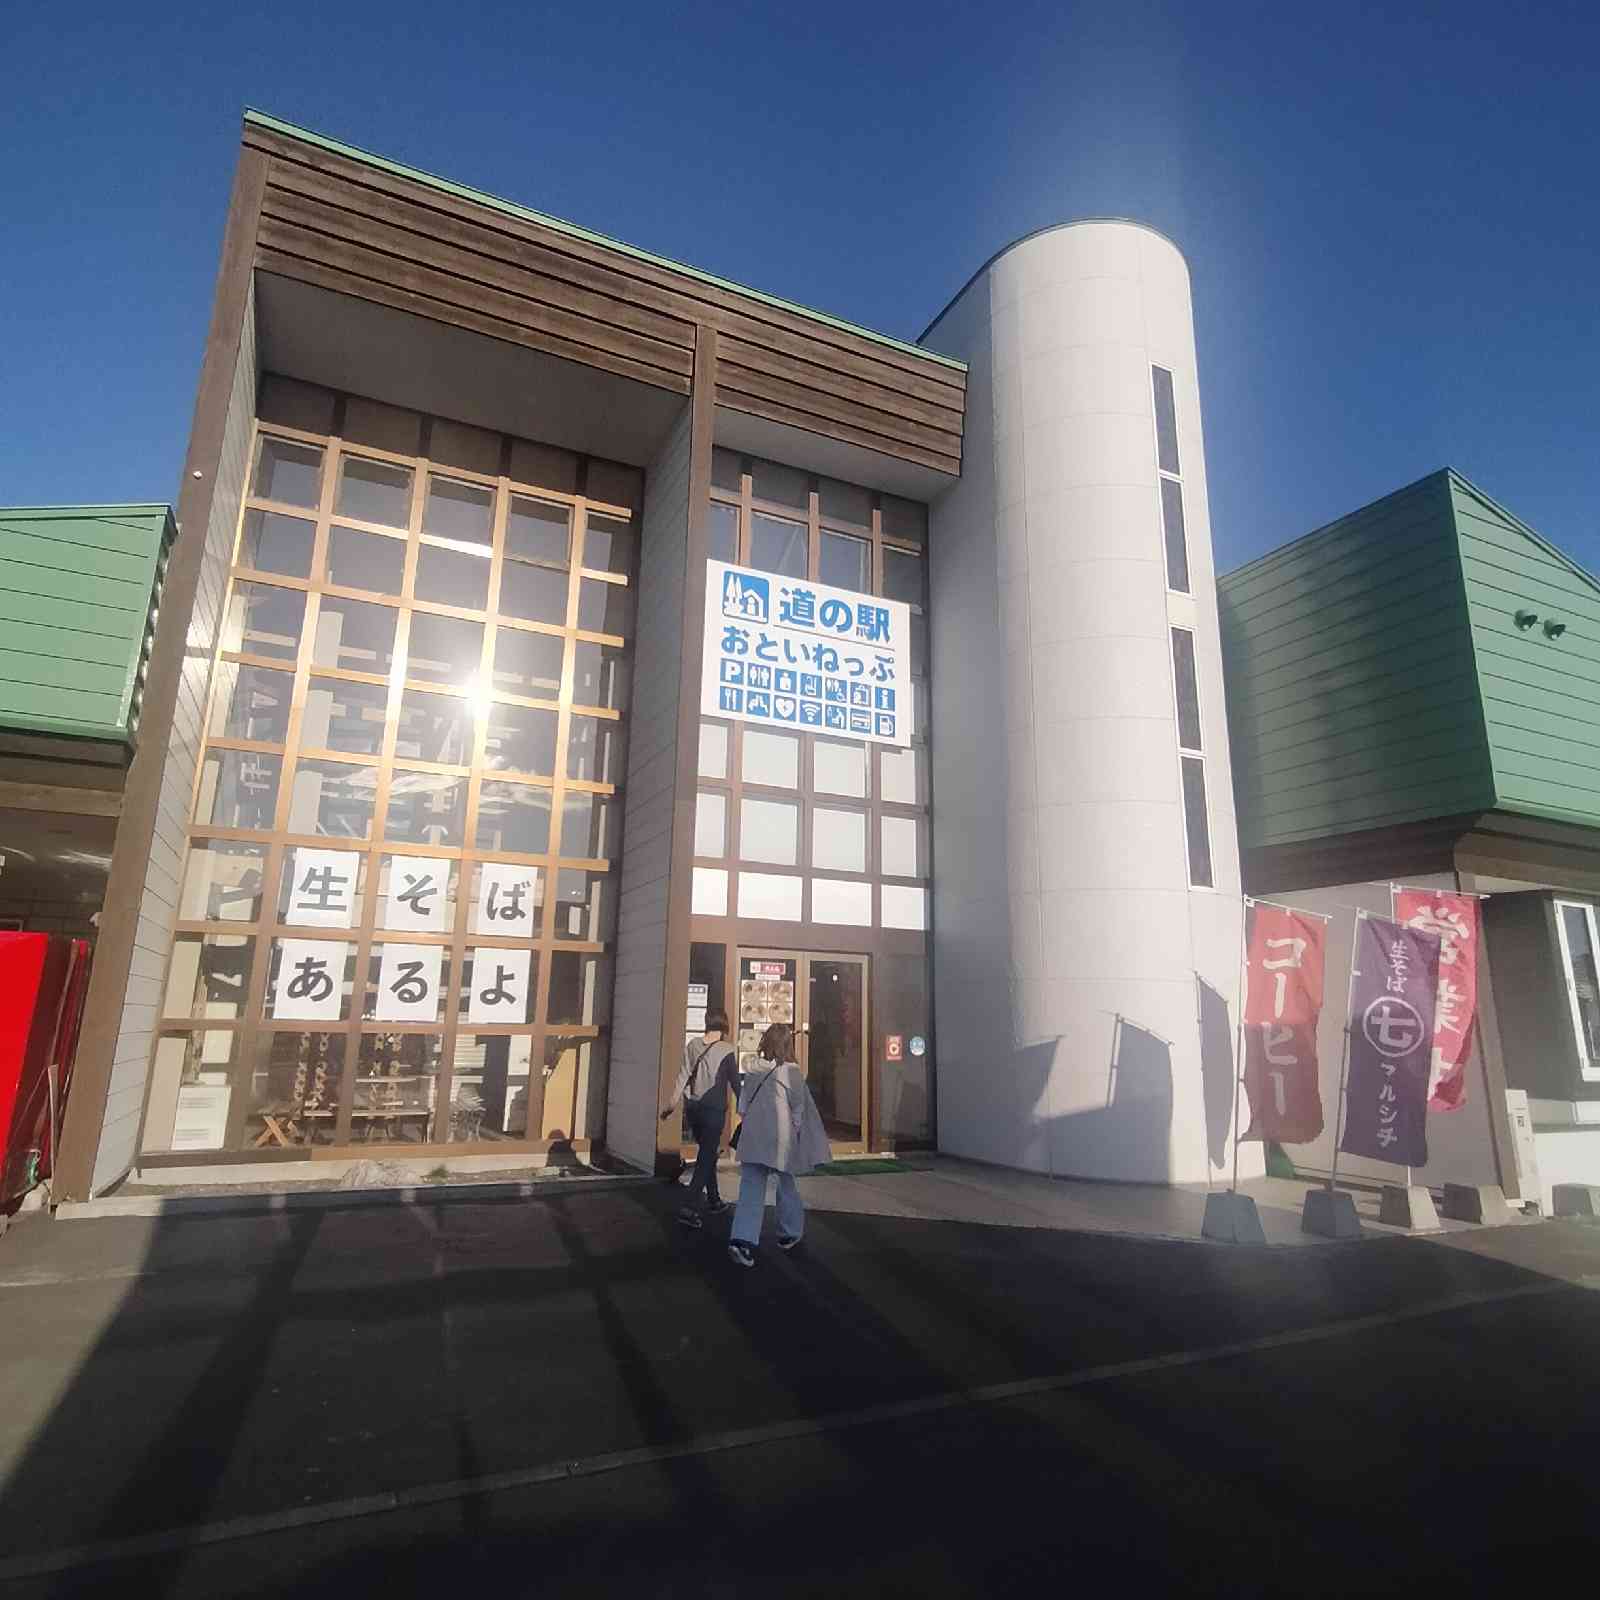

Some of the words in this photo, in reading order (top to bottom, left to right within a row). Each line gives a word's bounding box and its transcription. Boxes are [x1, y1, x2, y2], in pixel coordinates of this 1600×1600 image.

[779, 587, 890, 642] 道の駅
[721, 625, 895, 682] おといねっぷ
[297, 866, 531, 921] 生そば
[287, 957, 516, 1006] あるよ
[1386, 940, 1410, 993] 生そば
[1262, 937, 1306, 1116] コーヒー
[1376, 1062, 1398, 1147] マルシチ
